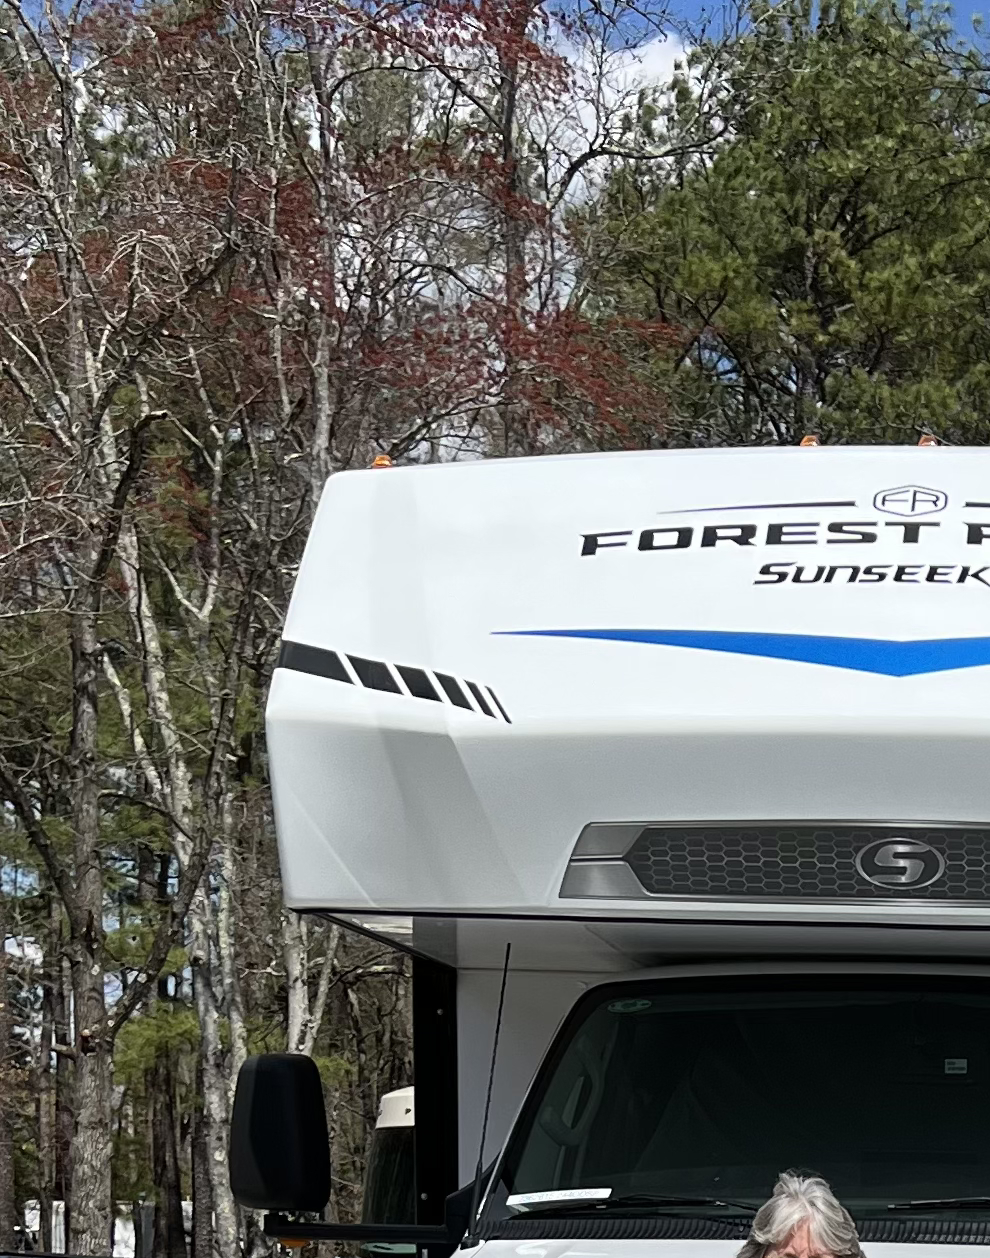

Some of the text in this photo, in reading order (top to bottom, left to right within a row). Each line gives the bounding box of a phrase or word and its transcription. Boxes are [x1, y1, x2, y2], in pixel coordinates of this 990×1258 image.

[881, 489, 940, 512] FR
[579, 522, 941, 558] FOREST
[869, 844, 930, 883] S
